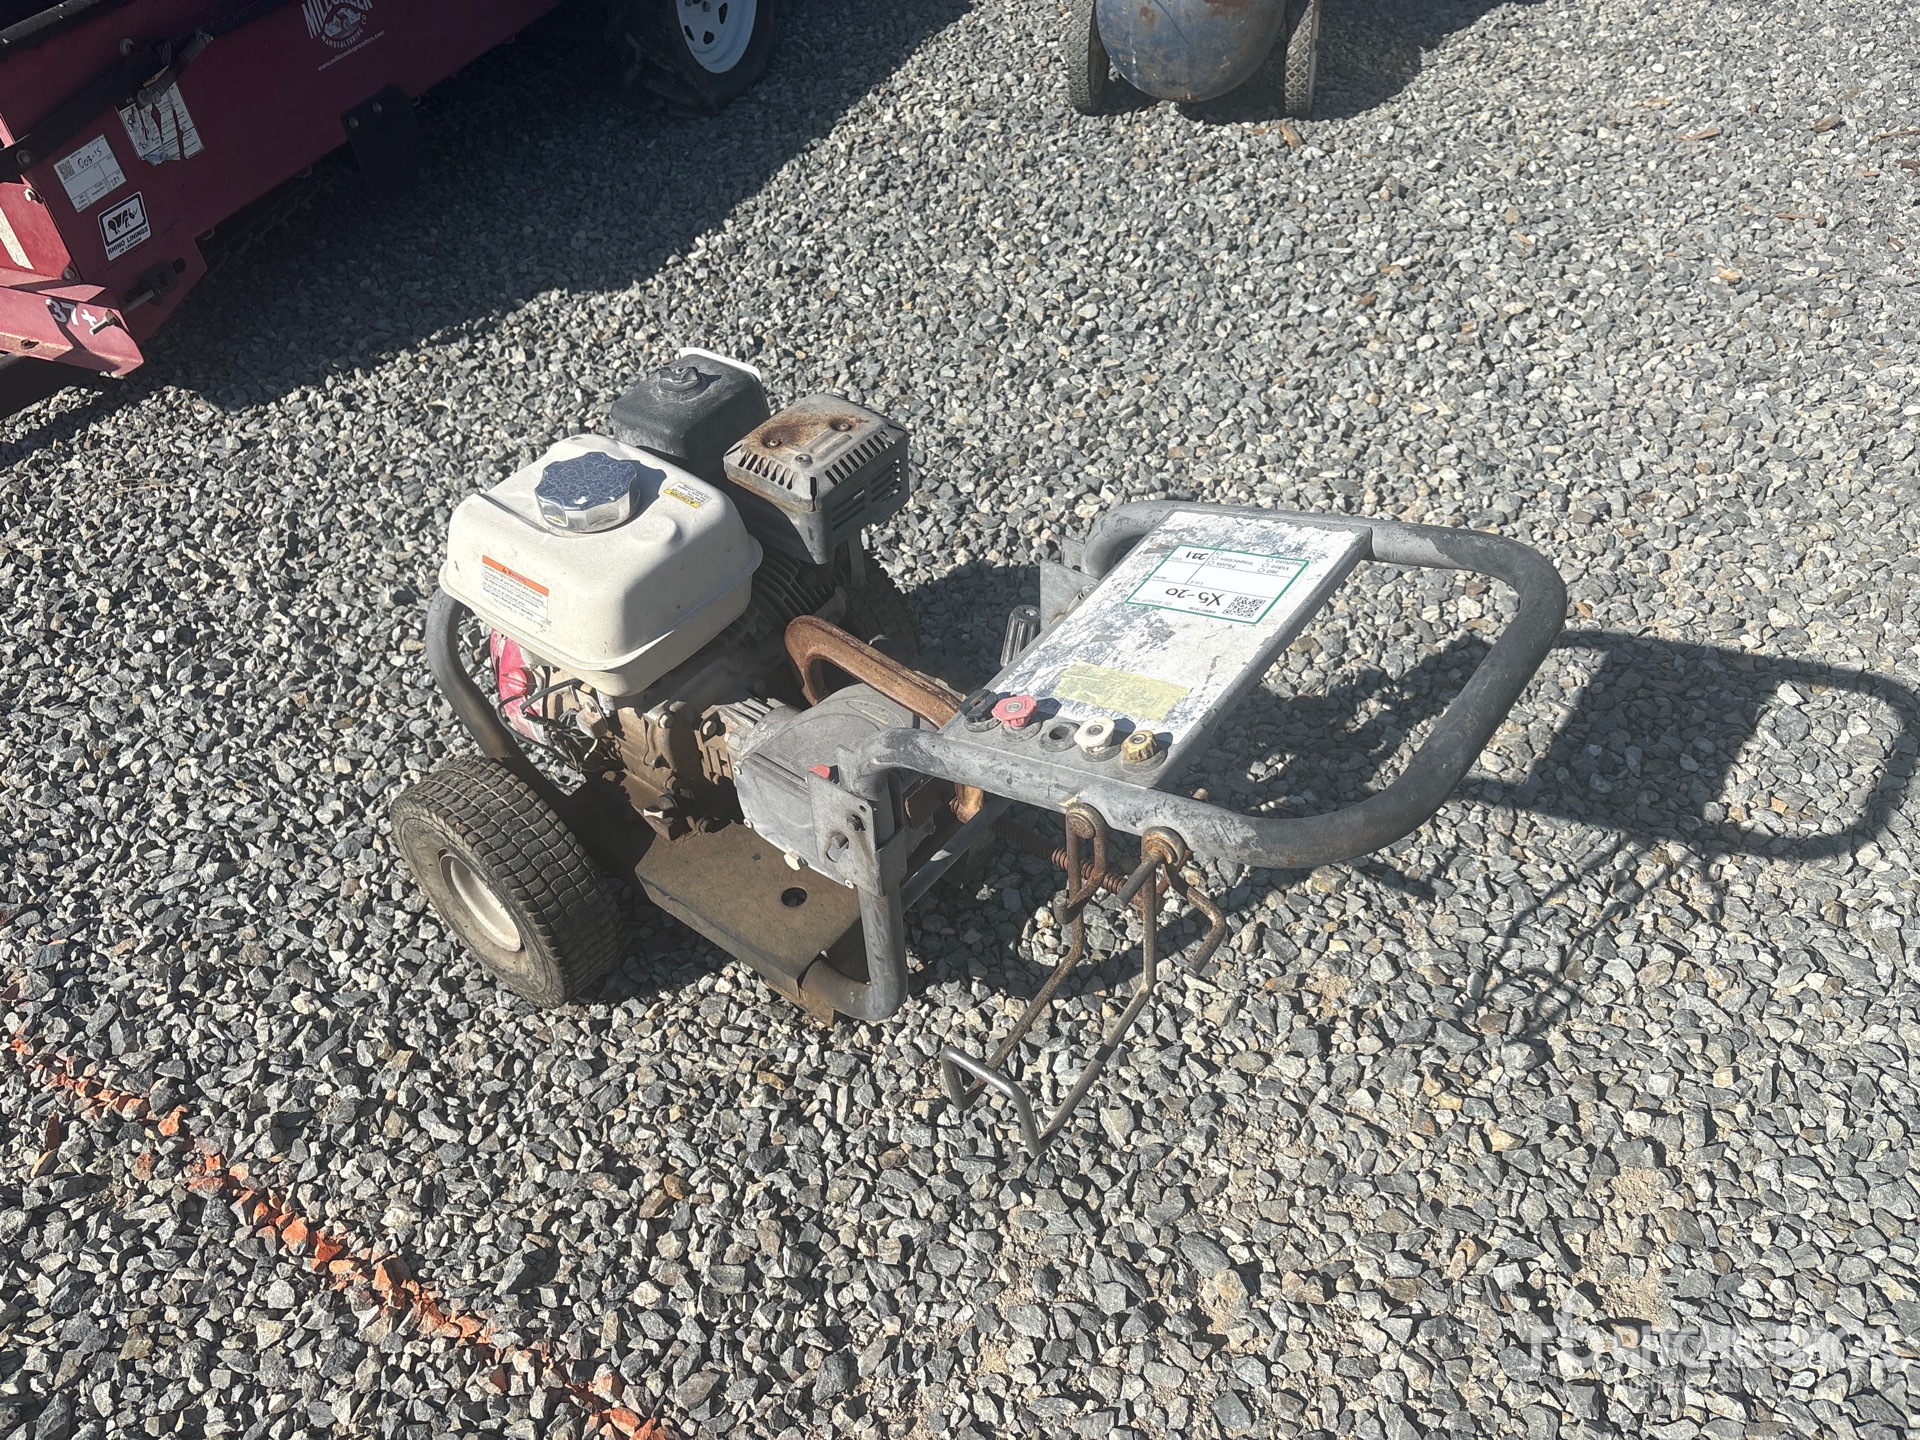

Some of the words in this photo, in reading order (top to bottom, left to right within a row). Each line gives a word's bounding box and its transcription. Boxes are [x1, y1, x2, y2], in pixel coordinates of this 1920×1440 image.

[108, 240, 126, 255] RHINO
[126, 227, 148, 243] LININGS
[1185, 551, 1209, 560] 221
[1220, 557, 1253, 565] Inspection
[1165, 588, 1225, 607] X5-20
